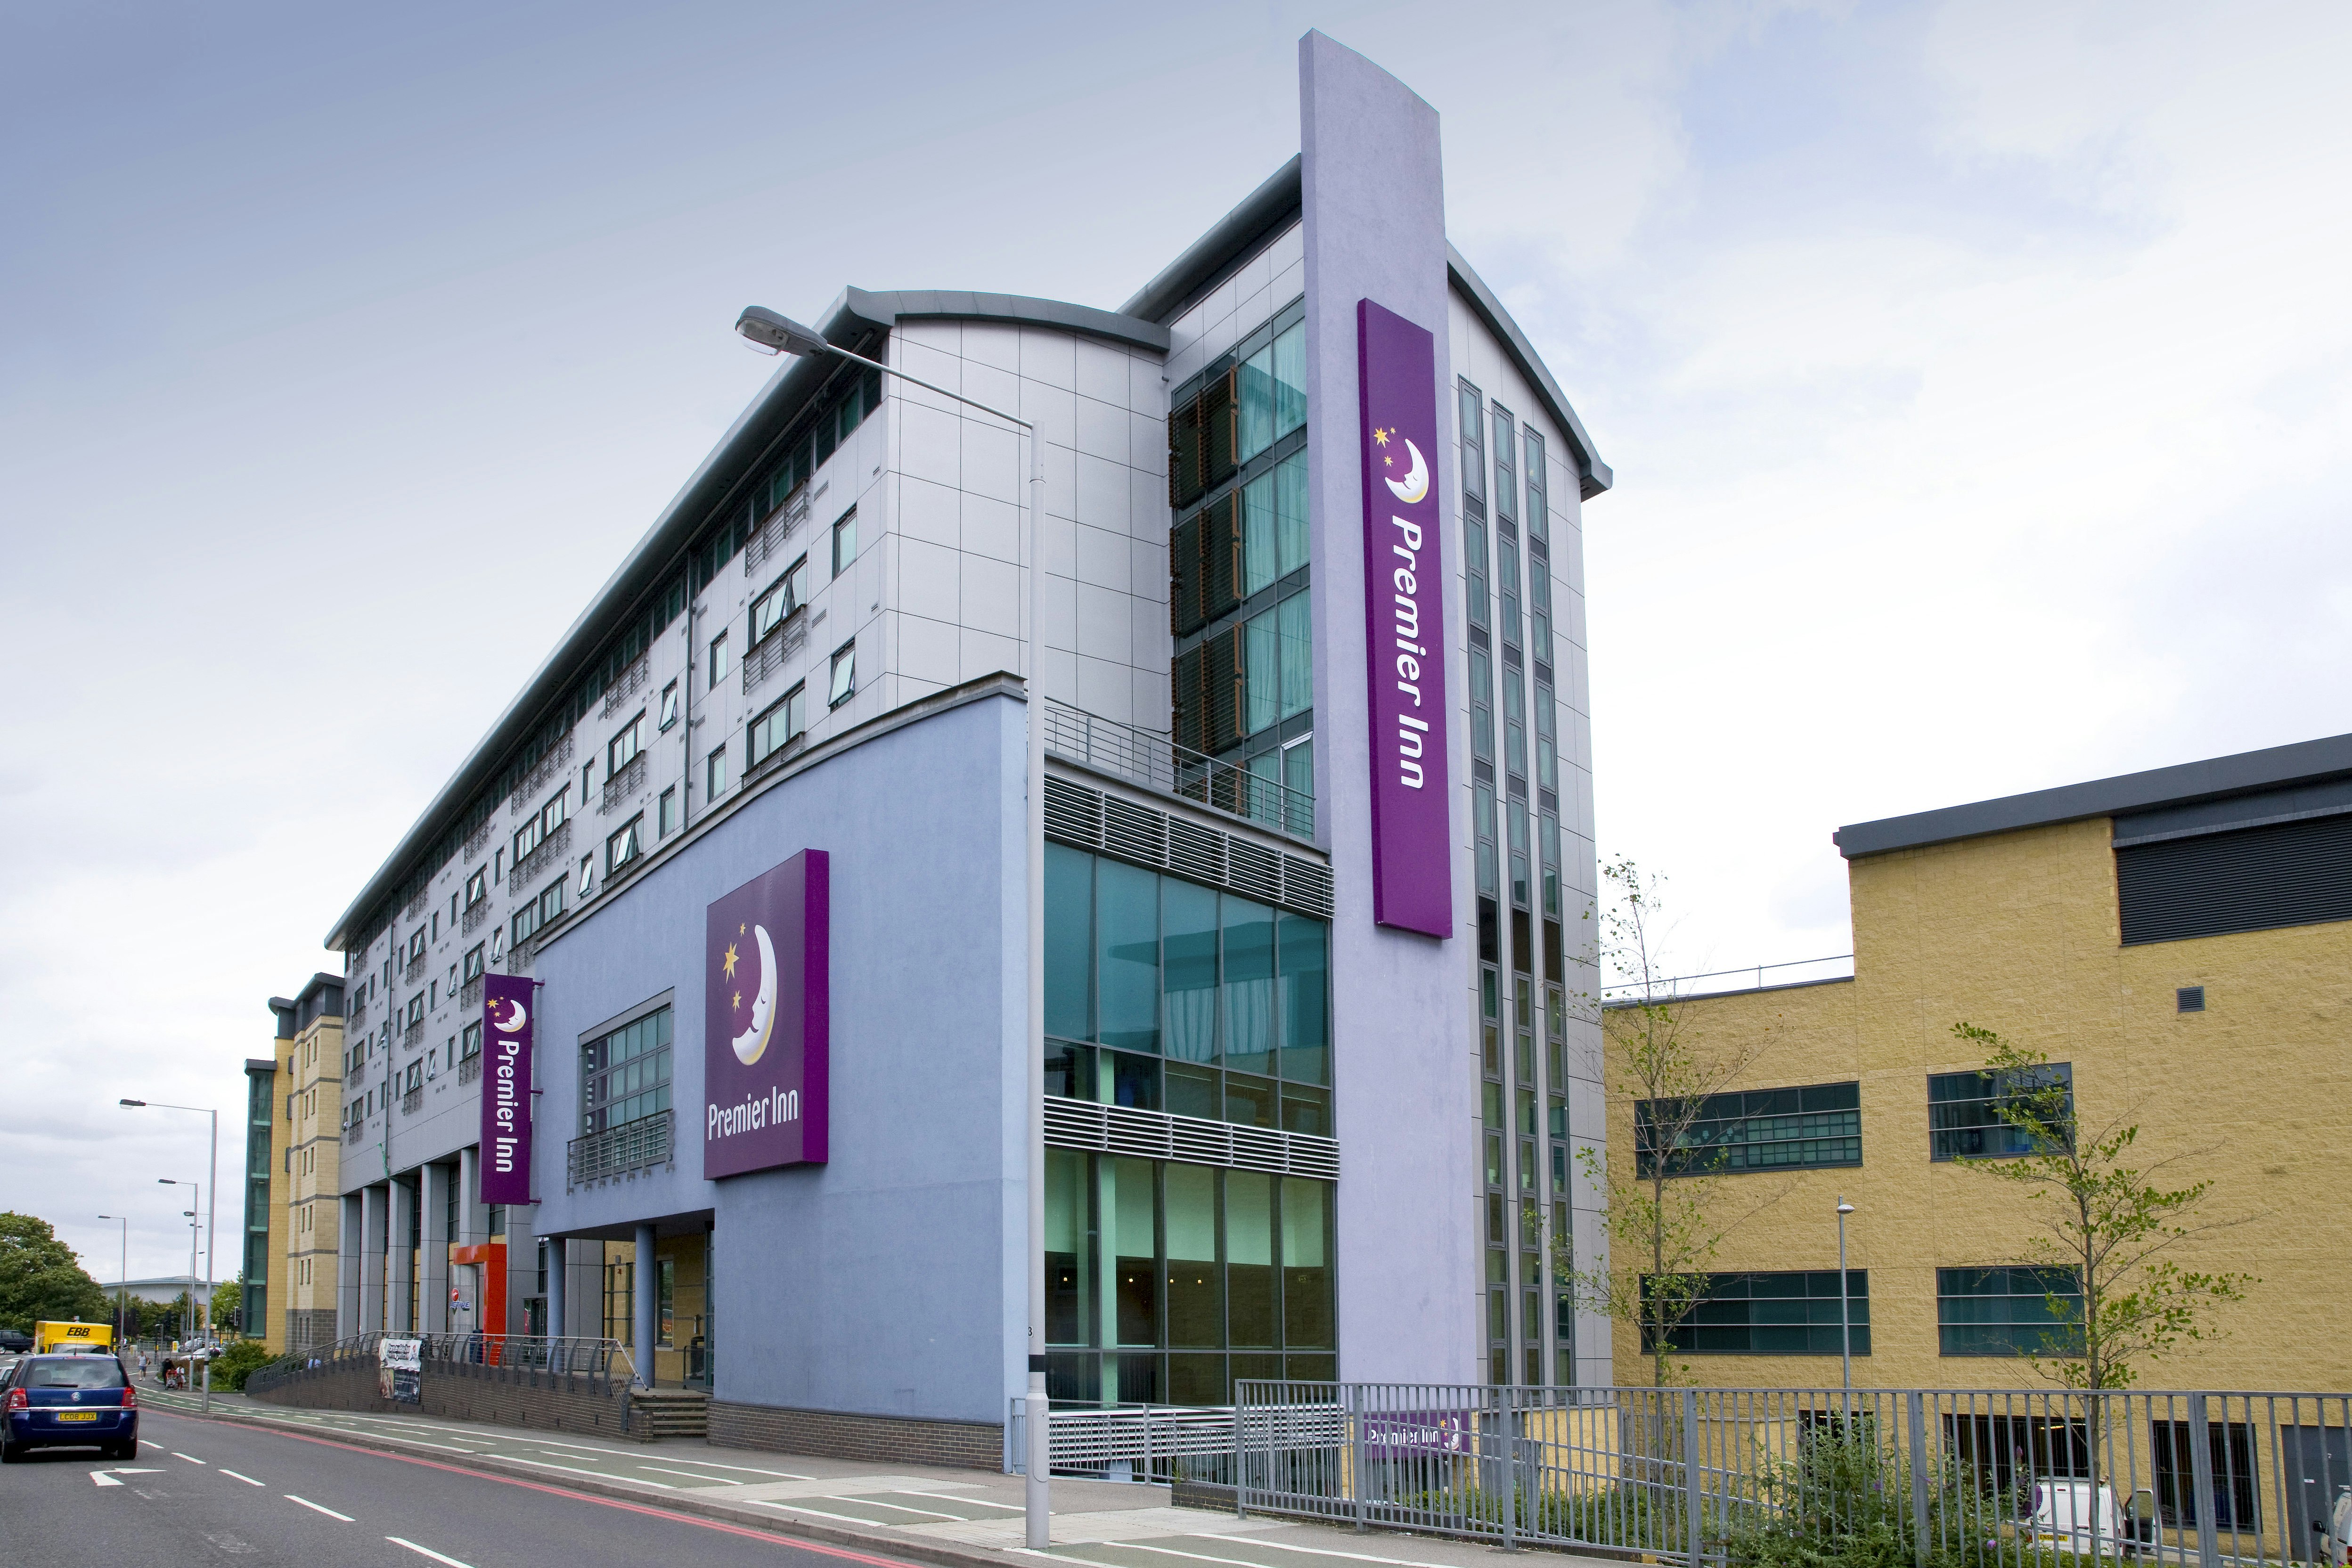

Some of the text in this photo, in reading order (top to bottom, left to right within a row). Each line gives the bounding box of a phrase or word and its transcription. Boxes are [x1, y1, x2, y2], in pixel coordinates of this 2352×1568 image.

[1392, 514, 1429, 789] Premier Inn
[496, 1040, 519, 1172] Premier Inn
[708, 1085, 798, 1141] Premier Inn
[66, 1327, 90, 1336] EBB
[1368, 1428, 1438, 1445] Premier Inn
